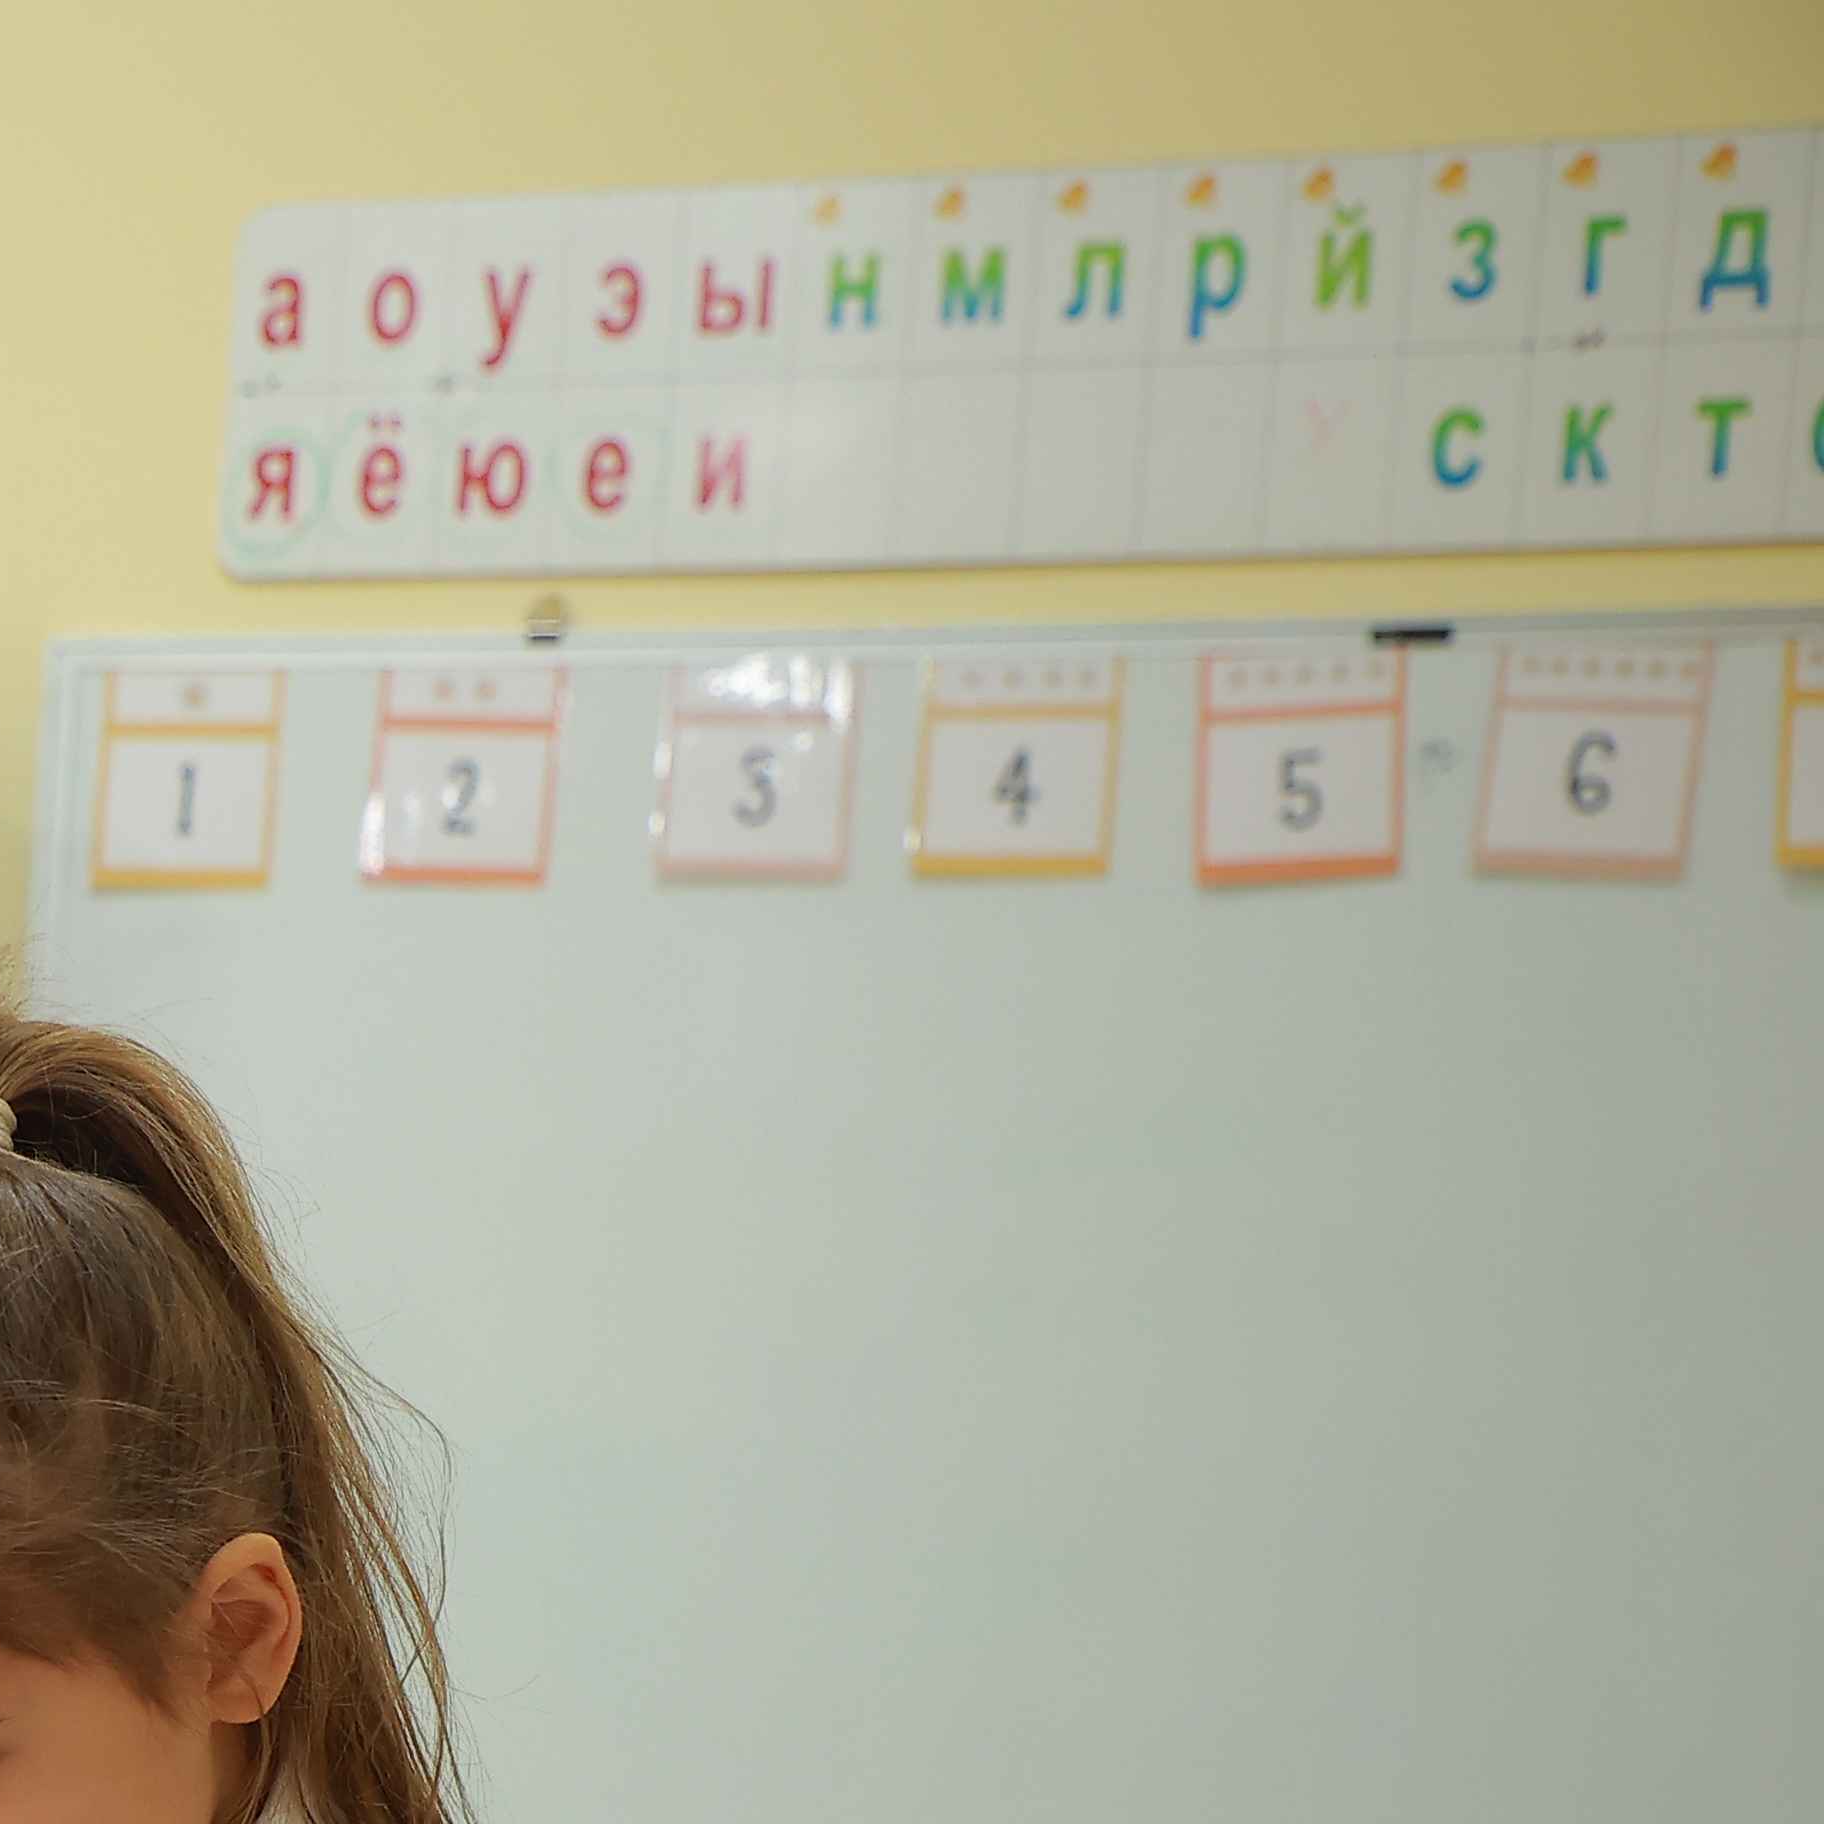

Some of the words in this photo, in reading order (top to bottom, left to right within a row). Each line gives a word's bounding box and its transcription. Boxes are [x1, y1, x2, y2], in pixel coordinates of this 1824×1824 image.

[260, 273, 302, 349] а
[371, 270, 418, 343] о
[481, 265, 534, 370] у
[597, 263, 643, 337] э
[697, 260, 775, 336] ы
[829, 252, 880, 328] н
[939, 247, 1004, 325] м
[1064, 241, 1126, 320] л
[1187, 232, 1246, 340] р
[1316, 205, 1371, 309] й
[1585, 214, 1627, 296] г
[1698, 209, 1770, 311] д
[248, 446, 297, 521] я
[360, 413, 403, 518] ё
[455, 442, 527, 516] ю
[585, 437, 629, 512] е
[695, 434, 748, 511] и
[1432, 405, 1484, 489] с
[1562, 405, 1613, 483] к
[1696, 396, 1751, 477] т
[176, 764, 197, 836] 1
[444, 759, 480, 837] 2
[732, 746, 778, 829] 3
[993, 744, 1041, 827] 4
[1276, 746, 1324, 831] 5
[1566, 730, 1618, 816] 6
